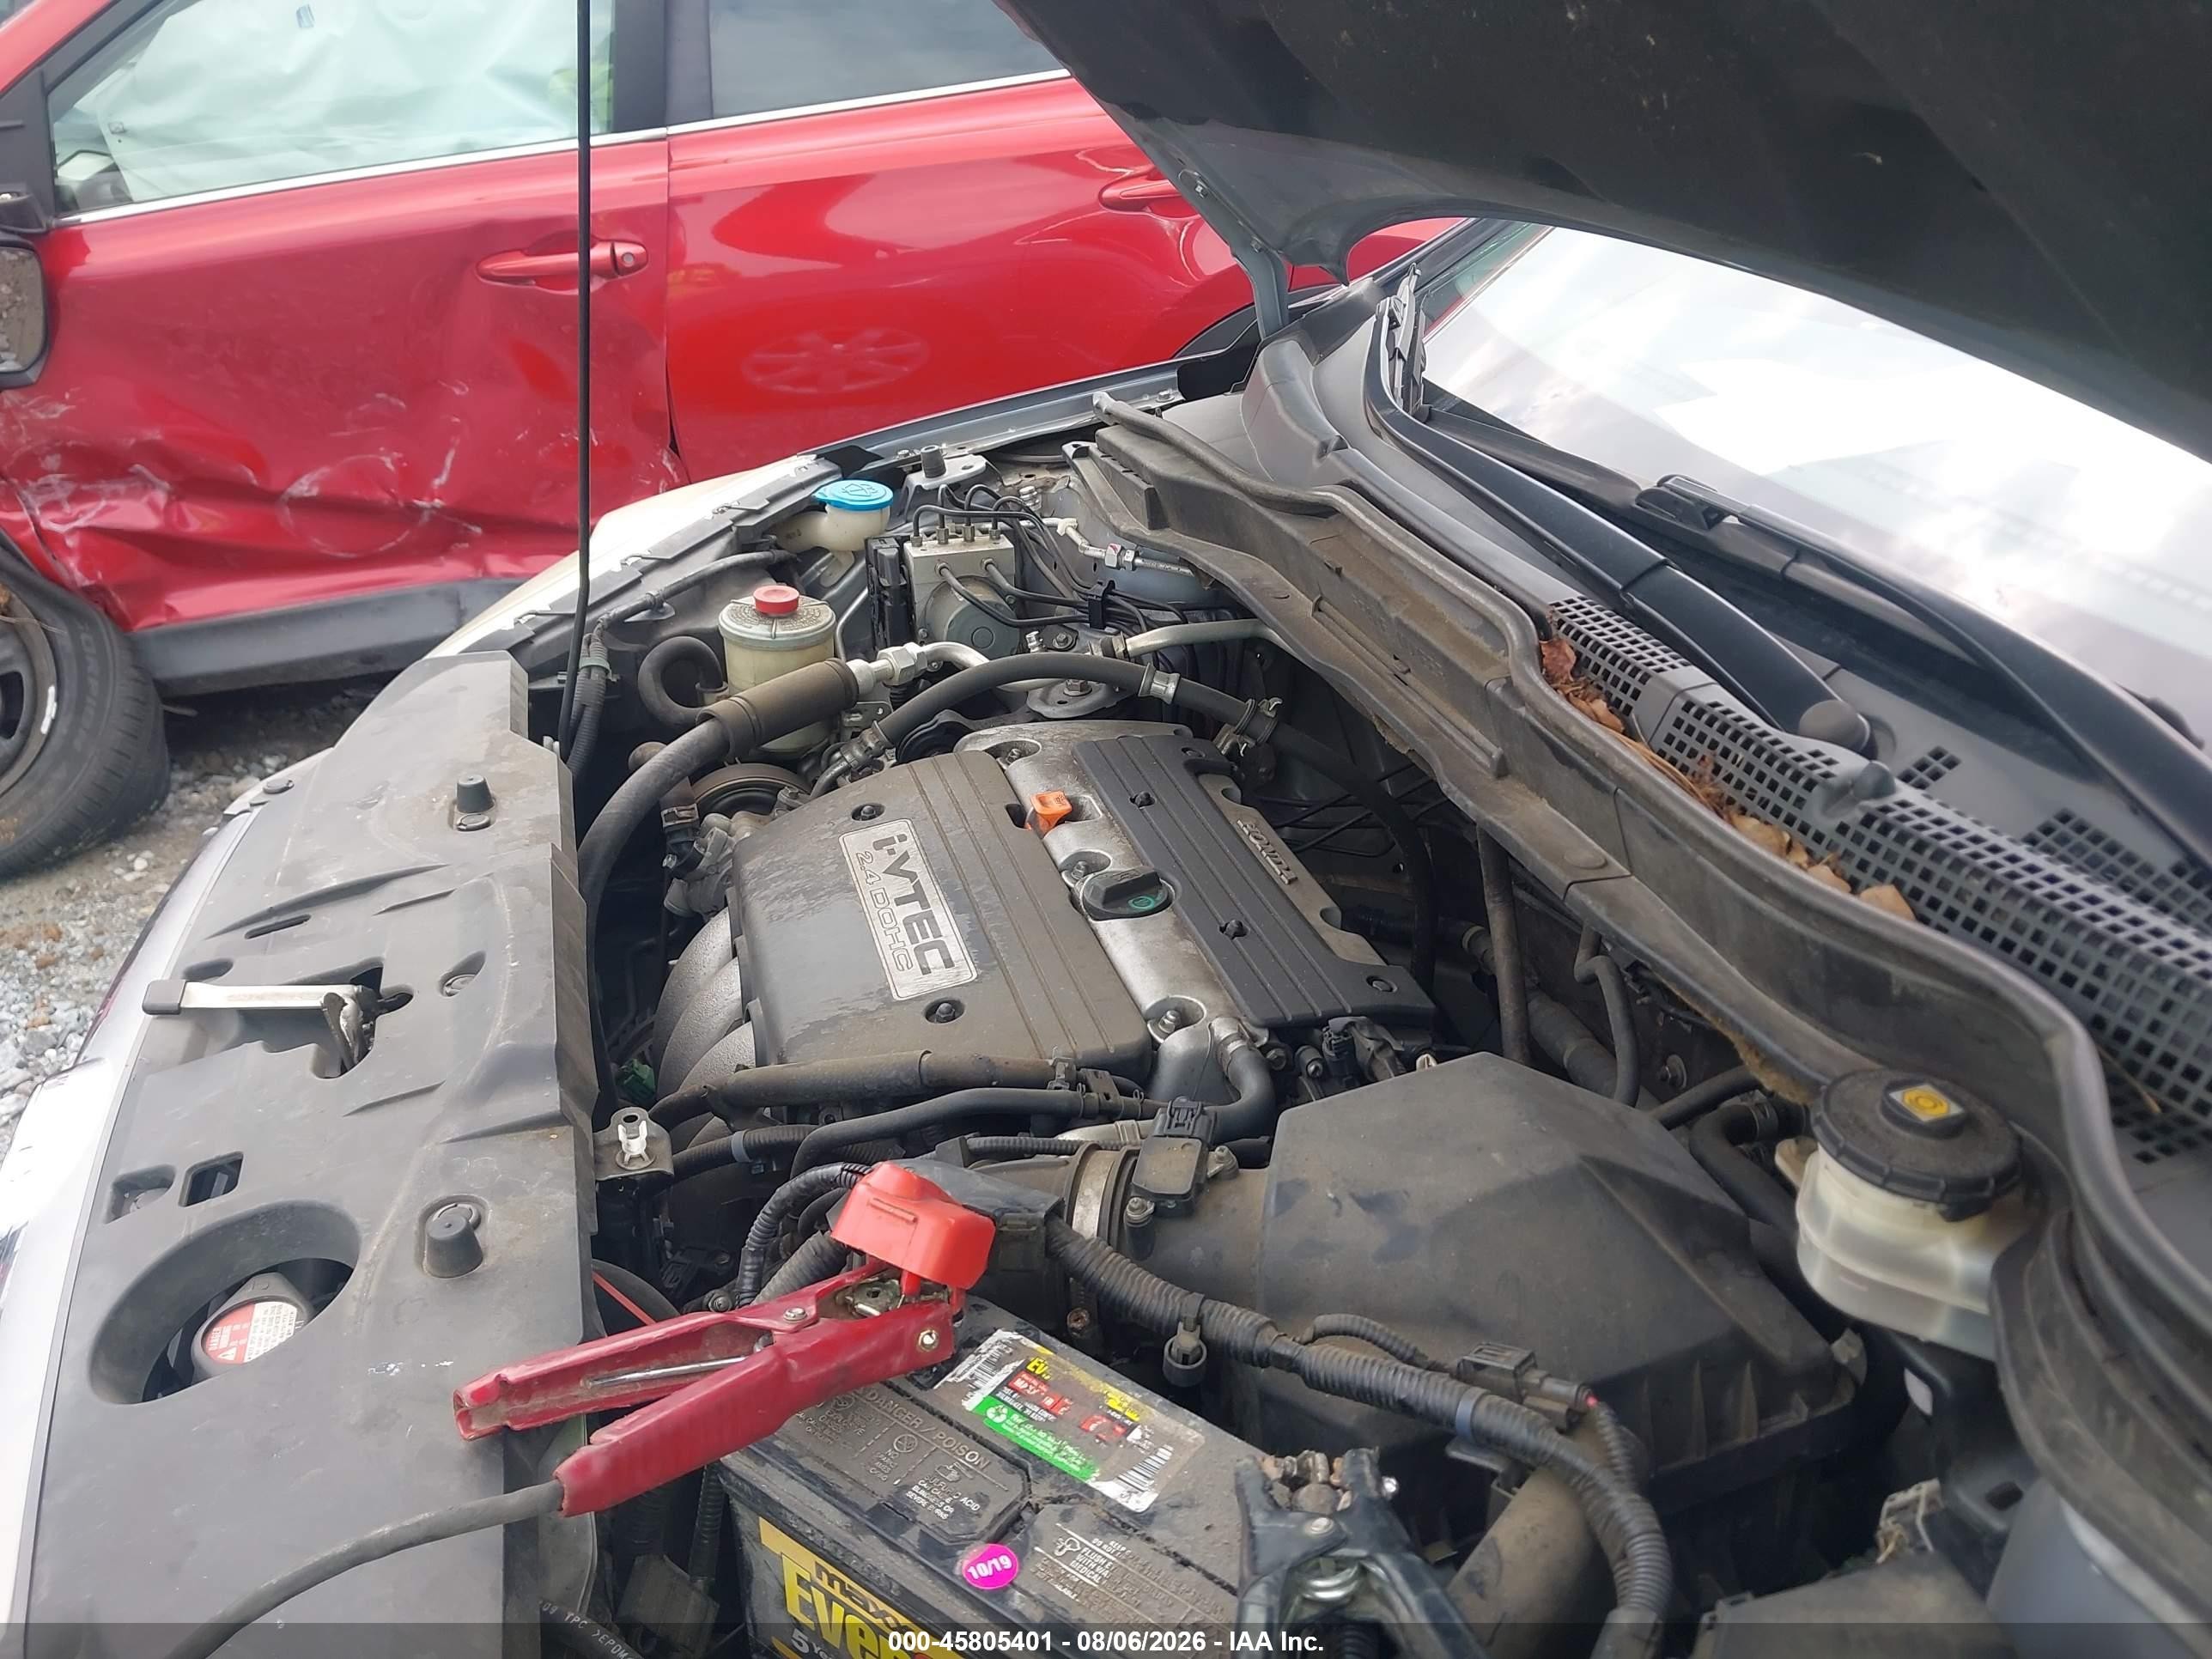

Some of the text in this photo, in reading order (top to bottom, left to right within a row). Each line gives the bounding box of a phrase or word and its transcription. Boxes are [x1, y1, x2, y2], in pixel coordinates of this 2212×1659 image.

[856, 851, 913, 971] 2.4 DOHC
[866, 1388, 921, 1430] DANGER
[933, 1431, 991, 1470] POISON
[906, 1491, 928, 1507] SEVERE
[931, 1488, 953, 1504] CAUE
[960, 1497, 981, 1511] ACID
[943, 1504, 955, 1514] OR
[1076, 1553, 1097, 1570] WITH
[1081, 1547, 1107, 1566] FLUSH
[967, 1555, 1012, 1580] 10/19
[1070, 1560, 1103, 1583] MEDICAL
[564, 1612, 588, 1629] TPC
[792, 1628, 810, 1654] 5
